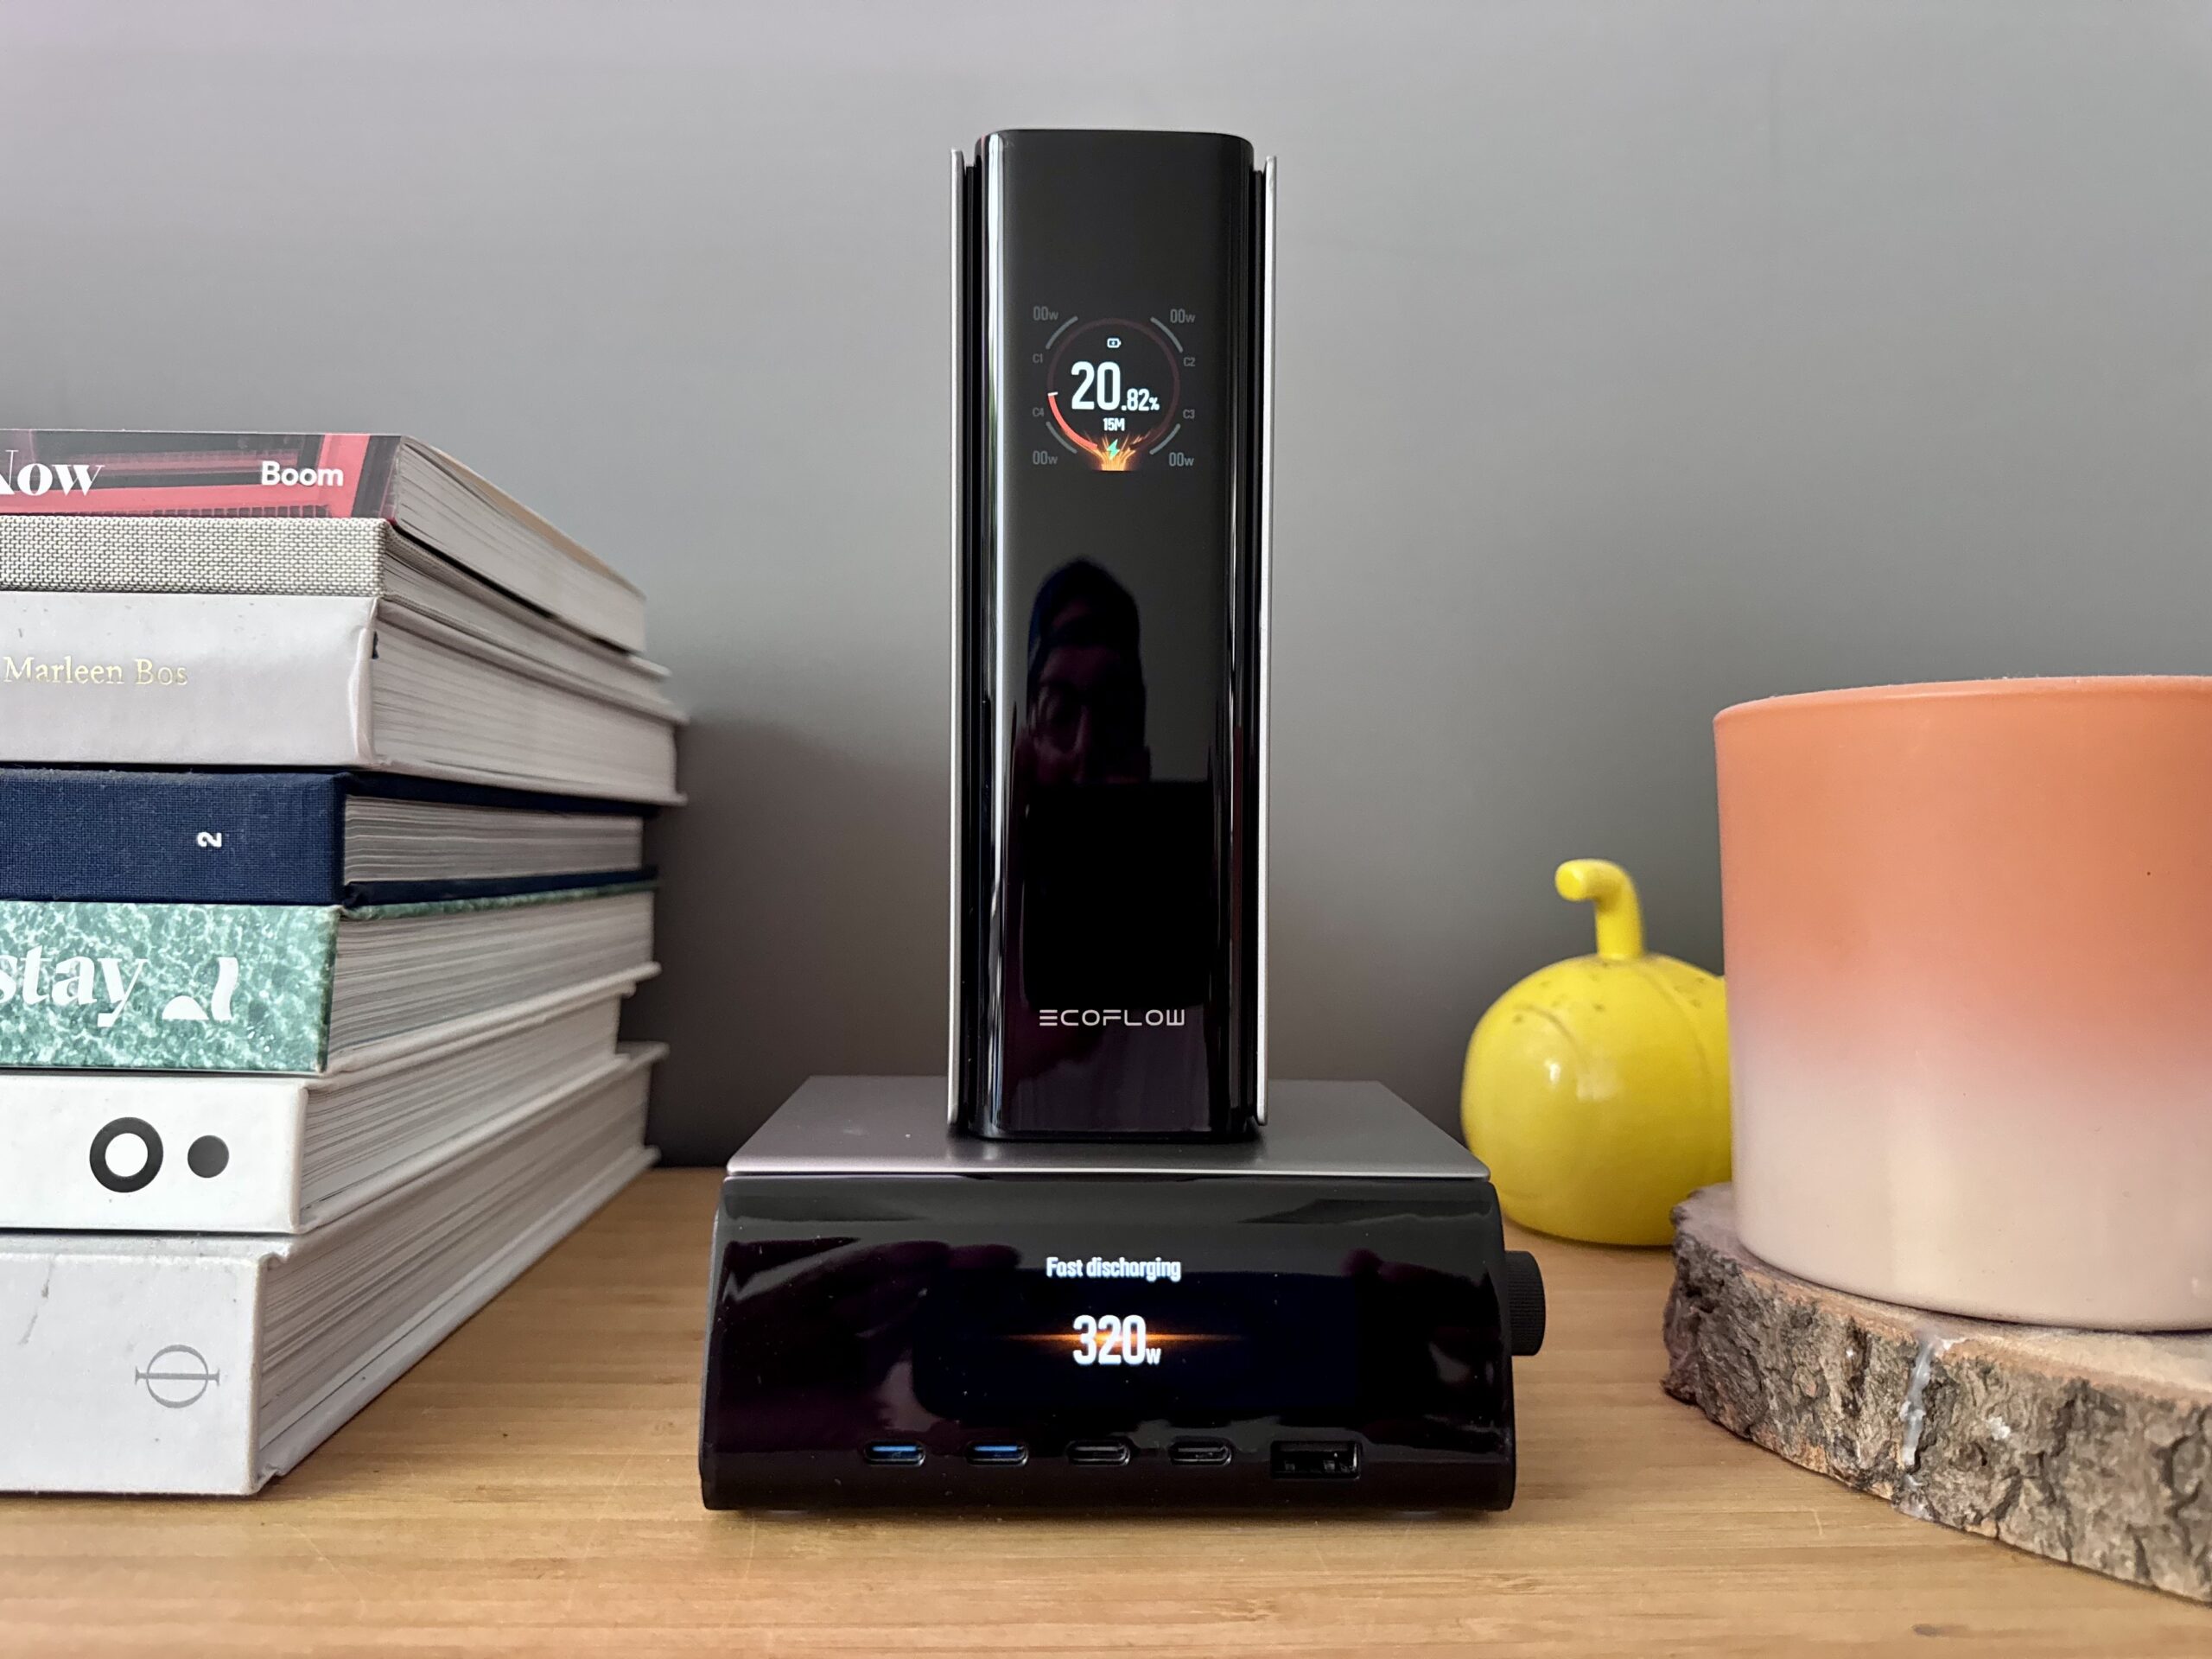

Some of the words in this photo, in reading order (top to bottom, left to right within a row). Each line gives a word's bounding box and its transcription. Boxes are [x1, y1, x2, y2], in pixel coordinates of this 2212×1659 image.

[1033, 353, 1044, 364] C1
[1183, 357, 1196, 367] C2
[1071, 360, 1160, 411] 20.82%
[1032, 407, 1045, 417] C4
[1182, 409, 1195, 420] C3
[1103, 417, 1125, 431] 15M
[261, 460, 344, 487] Boom
[3, 655, 125, 684] Marleen
[134, 658, 188, 685] Bos
[197, 831, 222, 849] 2
[1039, 1009, 1185, 1027] ECOFLOW
[1046, 1256, 1084, 1278] Fast
[1085, 1256, 1182, 1283] discharging
